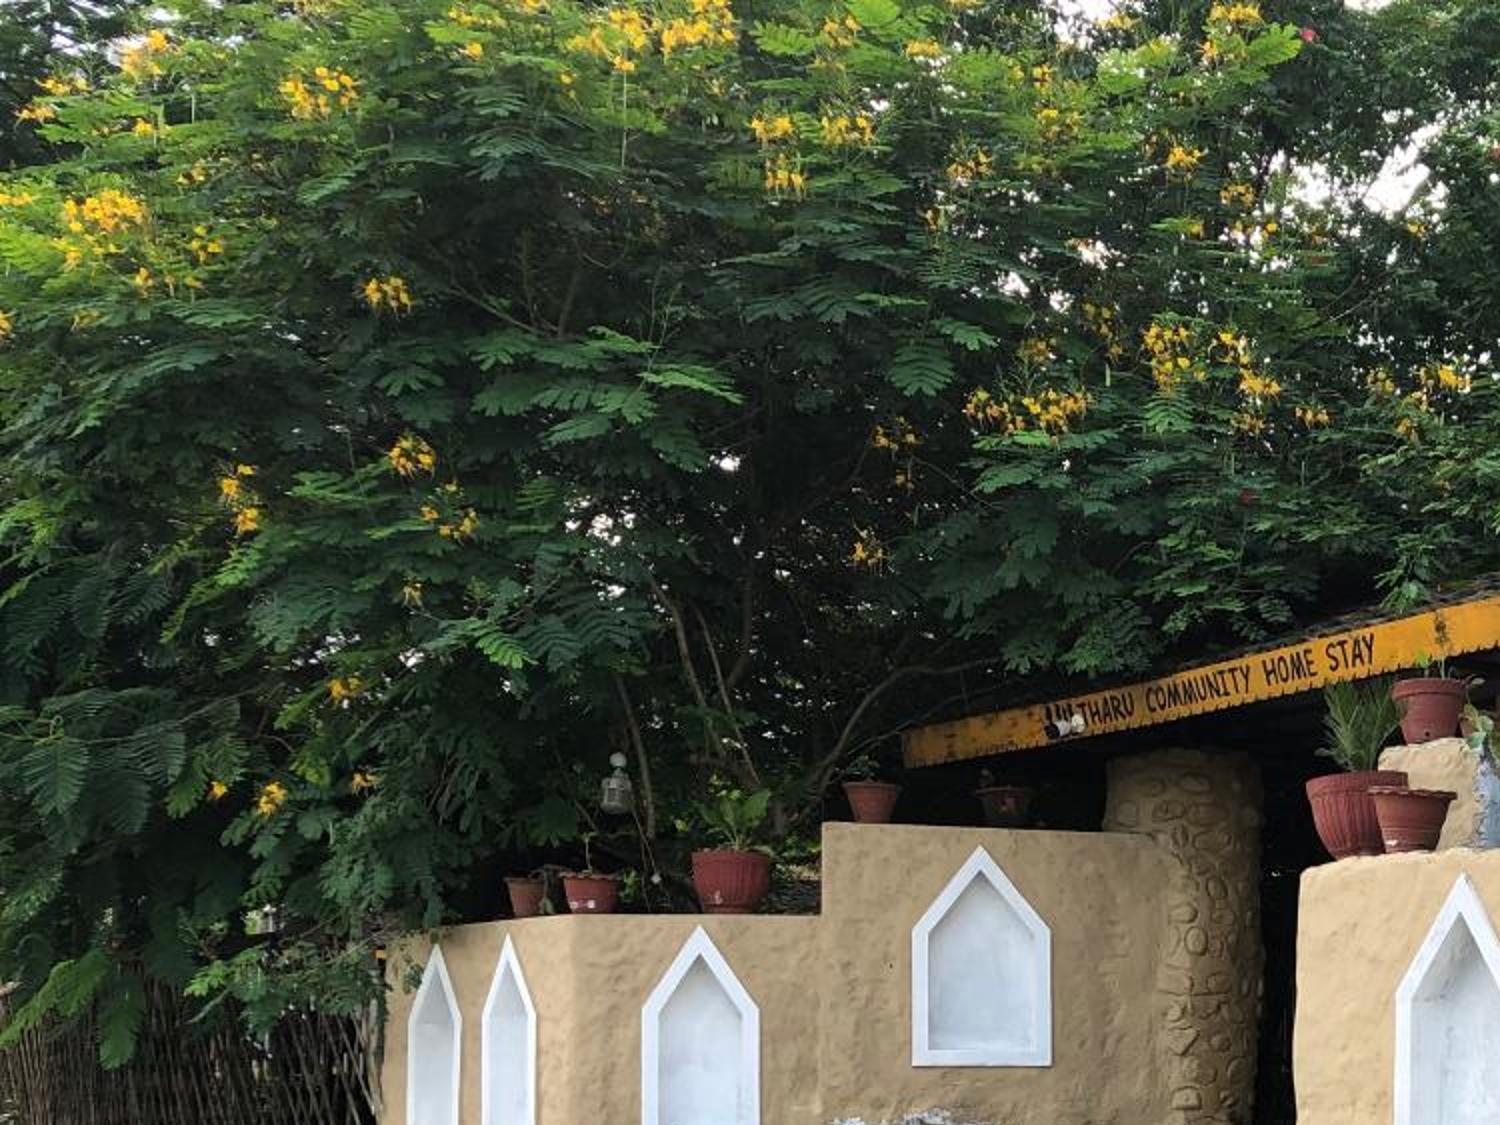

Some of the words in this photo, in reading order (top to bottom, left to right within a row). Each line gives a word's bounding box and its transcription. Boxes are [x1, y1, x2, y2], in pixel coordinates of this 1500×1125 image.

[1077, 691, 1135, 726] THARU
[1145, 665, 1250, 713] COMMUNITY
[1262, 648, 1318, 686] HOME
[1325, 633, 1375, 672] STAY
